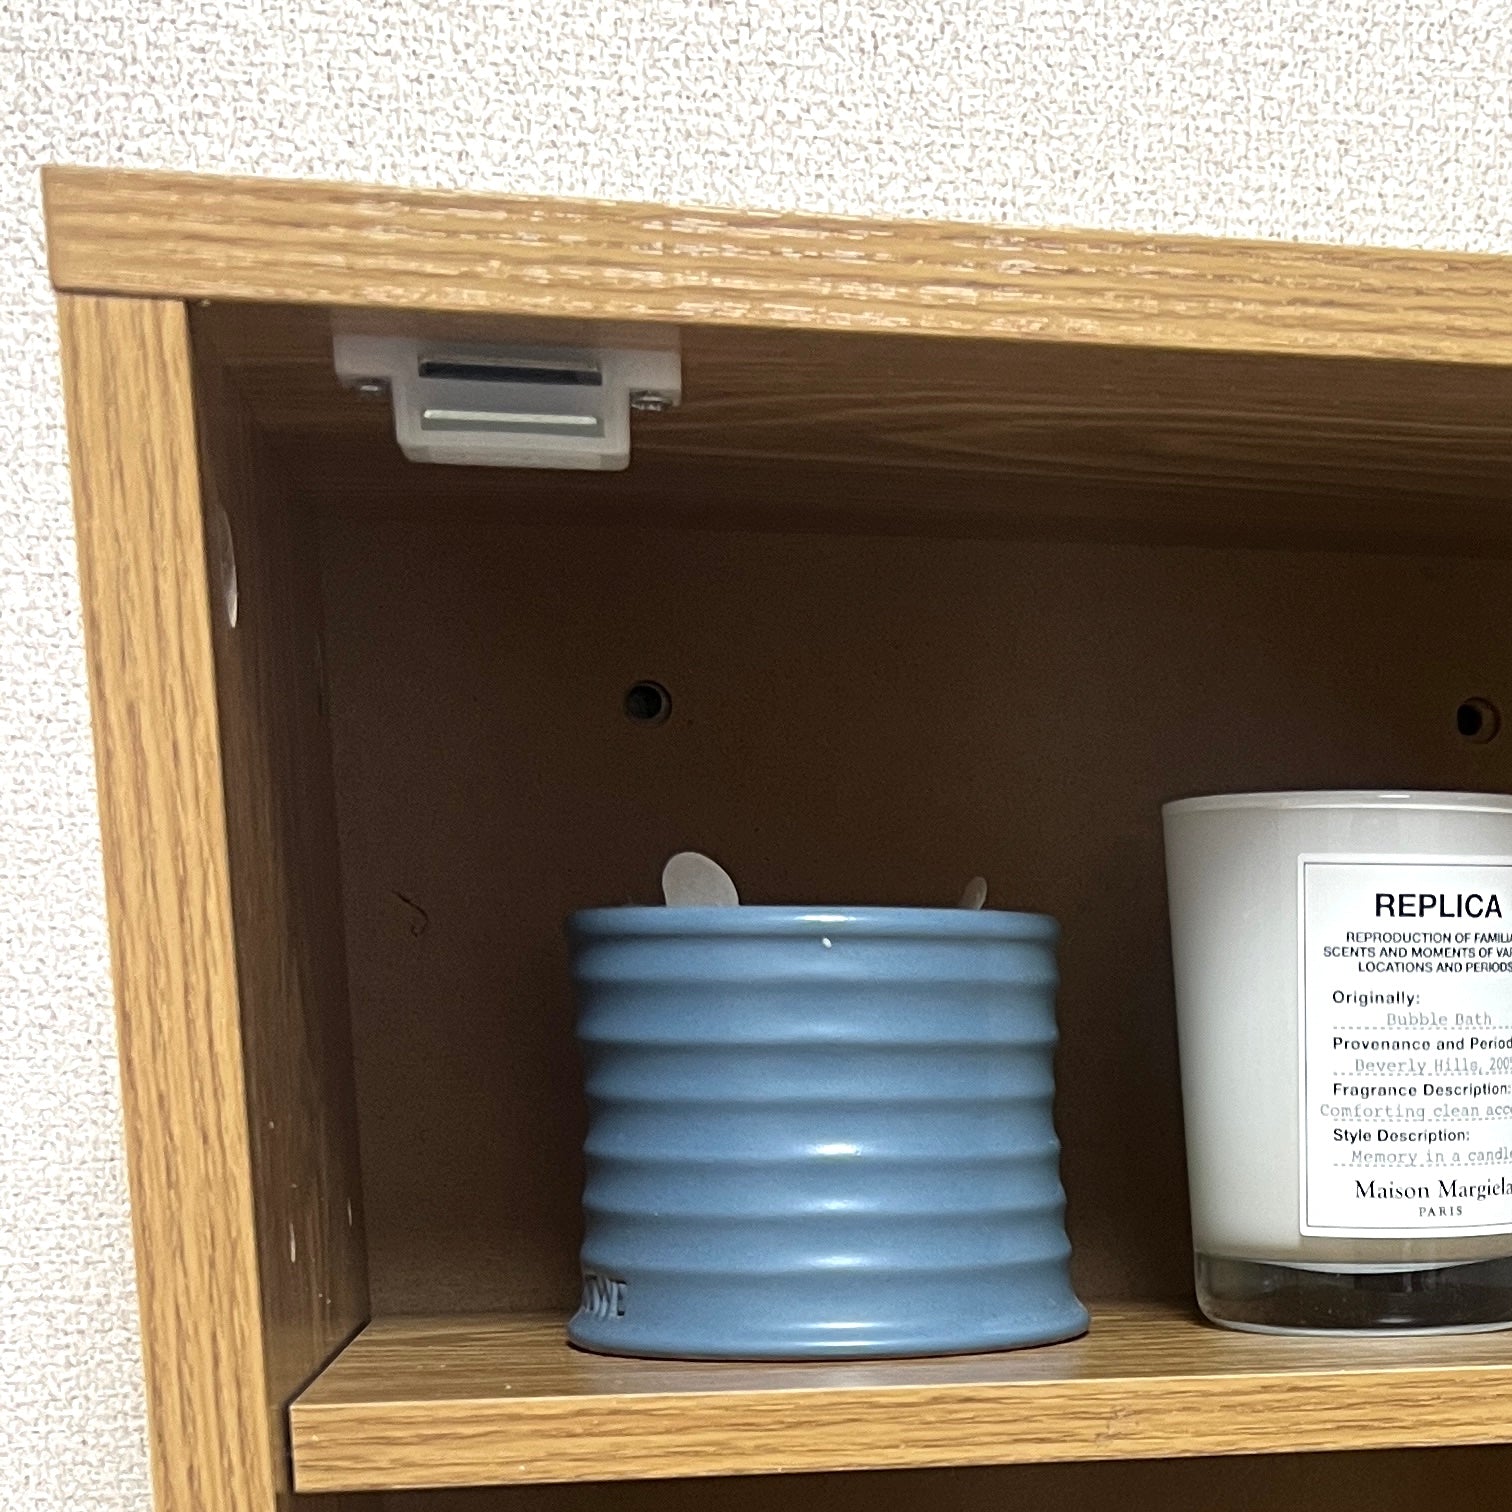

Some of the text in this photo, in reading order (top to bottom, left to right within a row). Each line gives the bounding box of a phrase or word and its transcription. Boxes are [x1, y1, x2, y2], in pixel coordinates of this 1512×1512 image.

[1375, 893, 1502, 918] REPLICA
[1346, 931, 1451, 944] REPRODUCTION
[1454, 932, 1471, 944] OF
[1323, 946, 1376, 958] SCENTS
[1379, 946, 1408, 958] AND
[1411, 946, 1476, 959] MOMENTS
[1478, 946, 1494, 958] OF
[1358, 961, 1433, 973] LOCATIONS
[1436, 961, 1463, 973] AND
[1332, 990, 1420, 1007] Originally:
[1387, 1011, 1493, 1027] Bubble Bath
[1333, 1036, 1430, 1051] Provenance
[1436, 1037, 1465, 1051] and
[1355, 1058, 1427, 1076] Beverly
[1435, 1057, 1484, 1076] Hills,
[1333, 1081, 1512, 1099] Fragrance Description:
[1320, 1103, 1426, 1122] Comforting
[1433, 1103, 1479, 1117] clean
[1333, 1128, 1470, 1144] Style Description:
[1352, 1150, 1418, 1167] Memory
[1426, 1149, 1445, 1163] in
[1451, 1151, 1461, 1163] a
[1355, 1179, 1430, 1199] Maison
[1418, 1205, 1463, 1217] PARIS
